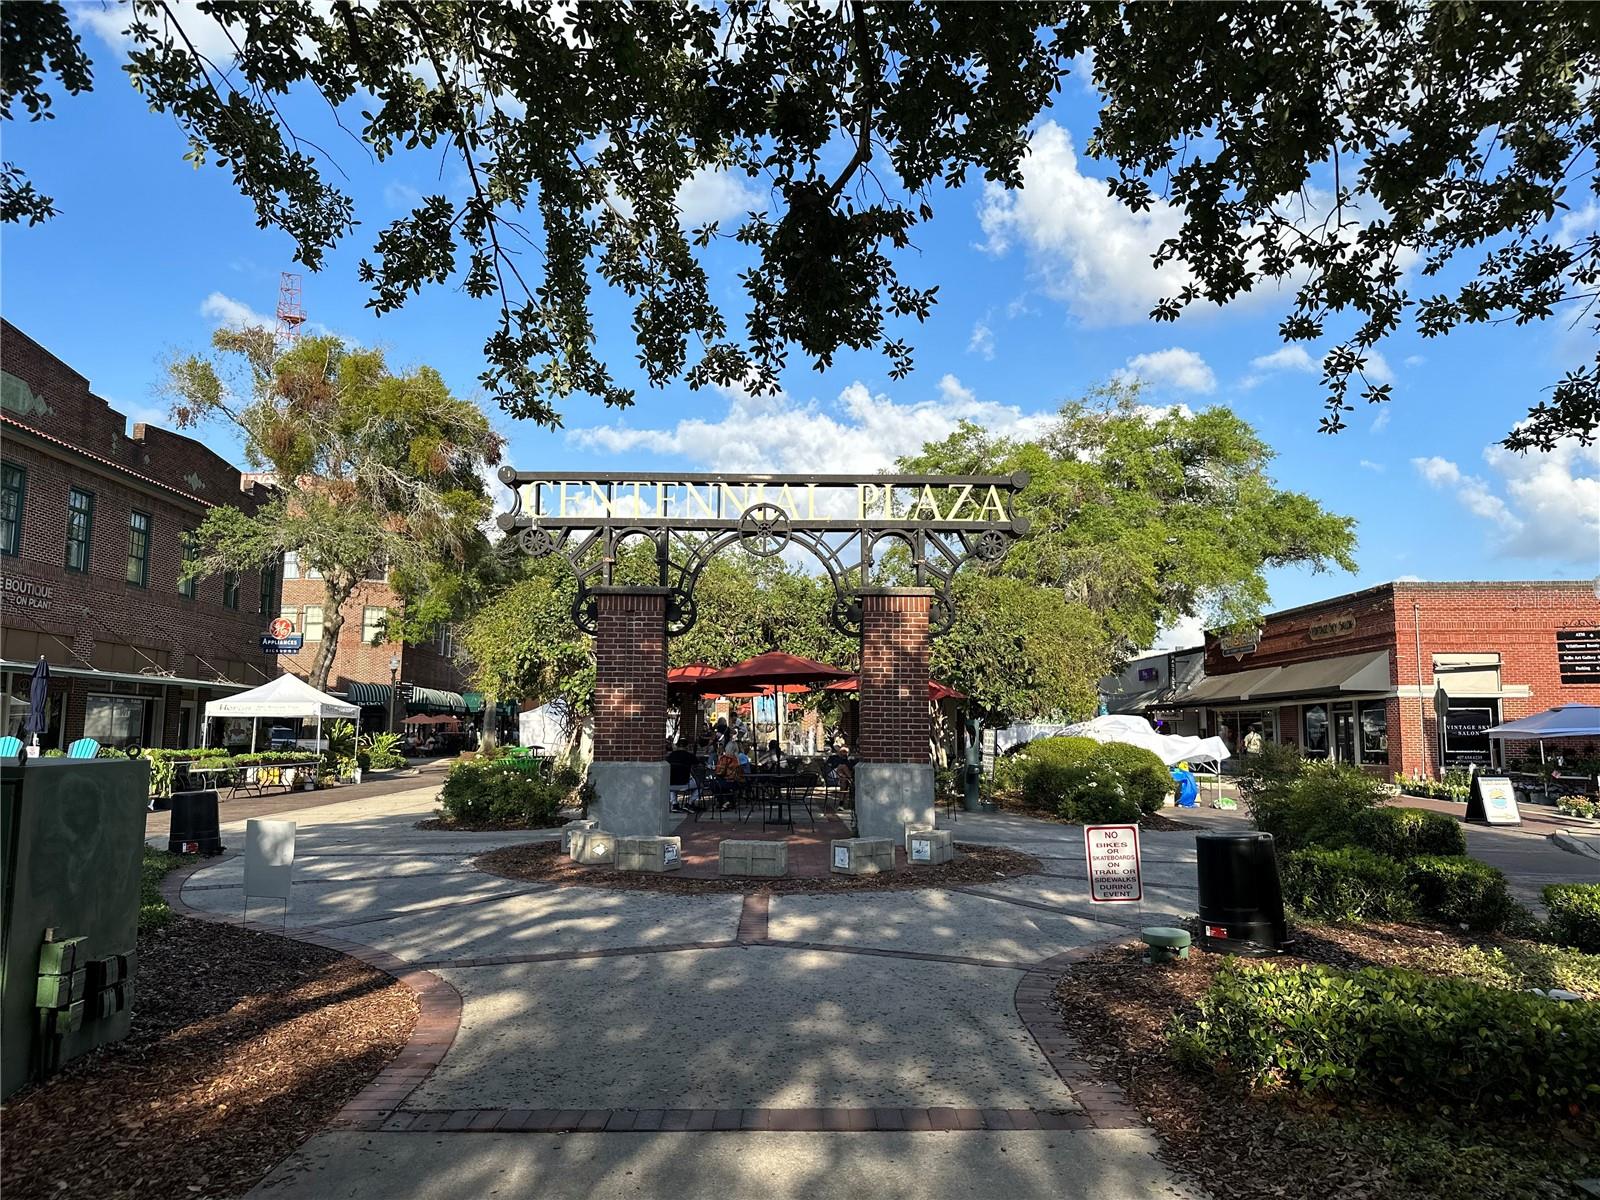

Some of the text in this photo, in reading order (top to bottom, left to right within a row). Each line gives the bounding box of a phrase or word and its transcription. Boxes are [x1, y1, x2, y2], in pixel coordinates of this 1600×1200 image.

[523, 480, 1012, 522] CENTENNIAL PLAZA
[5, 578, 53, 599] BOUTIQUE
[16, 595, 51, 610] ON PLANT
[262, 638, 298, 646] APPLIANCES
[1104, 831, 1118, 839] NO
[1103, 890, 1131, 898] EVENT
